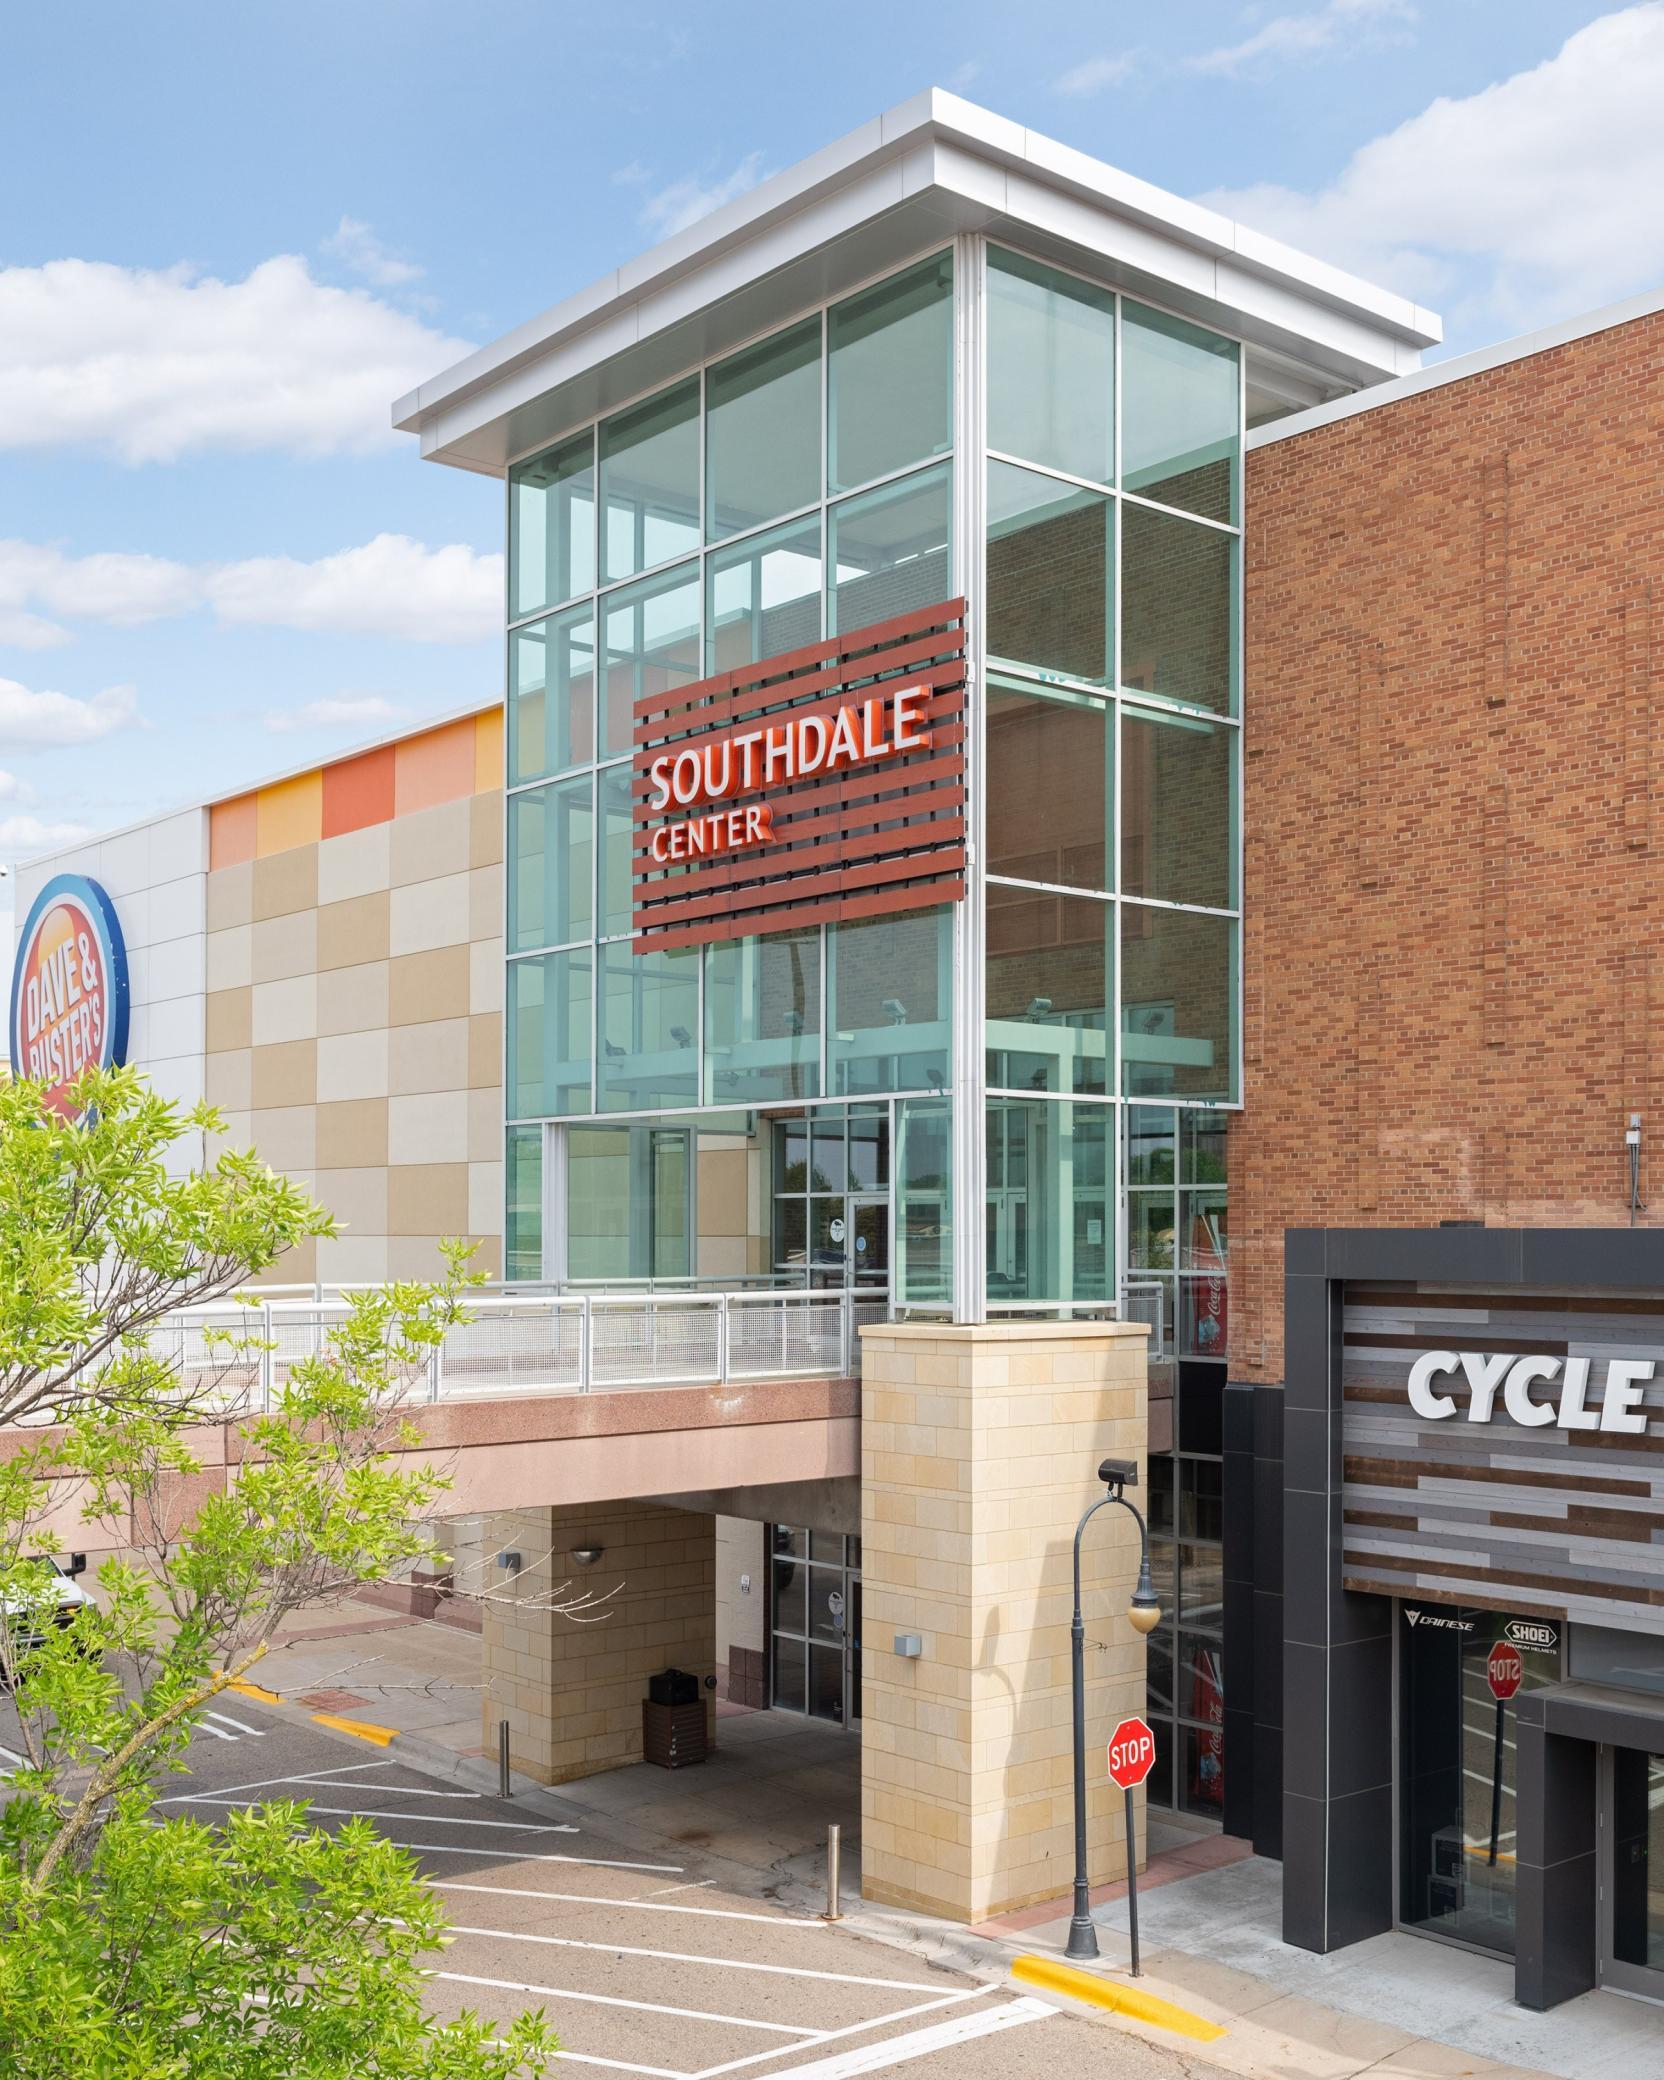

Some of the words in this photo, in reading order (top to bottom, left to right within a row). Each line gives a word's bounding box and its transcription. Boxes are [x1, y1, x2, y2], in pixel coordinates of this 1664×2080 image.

[650, 684, 932, 813] SOUTHDALE
[652, 803, 775, 863] CENTER
[26, 937, 81, 1042] DAVE
[78, 931, 99, 993] &
[29, 992, 100, 1092] BUSTER'S
[1407, 1350, 1656, 1434] CYCLE
[1419, 1616, 1475, 1631] DAINESE
[1512, 1624, 1550, 1643] SHOEI
[1111, 1736, 1151, 1771] STOP
